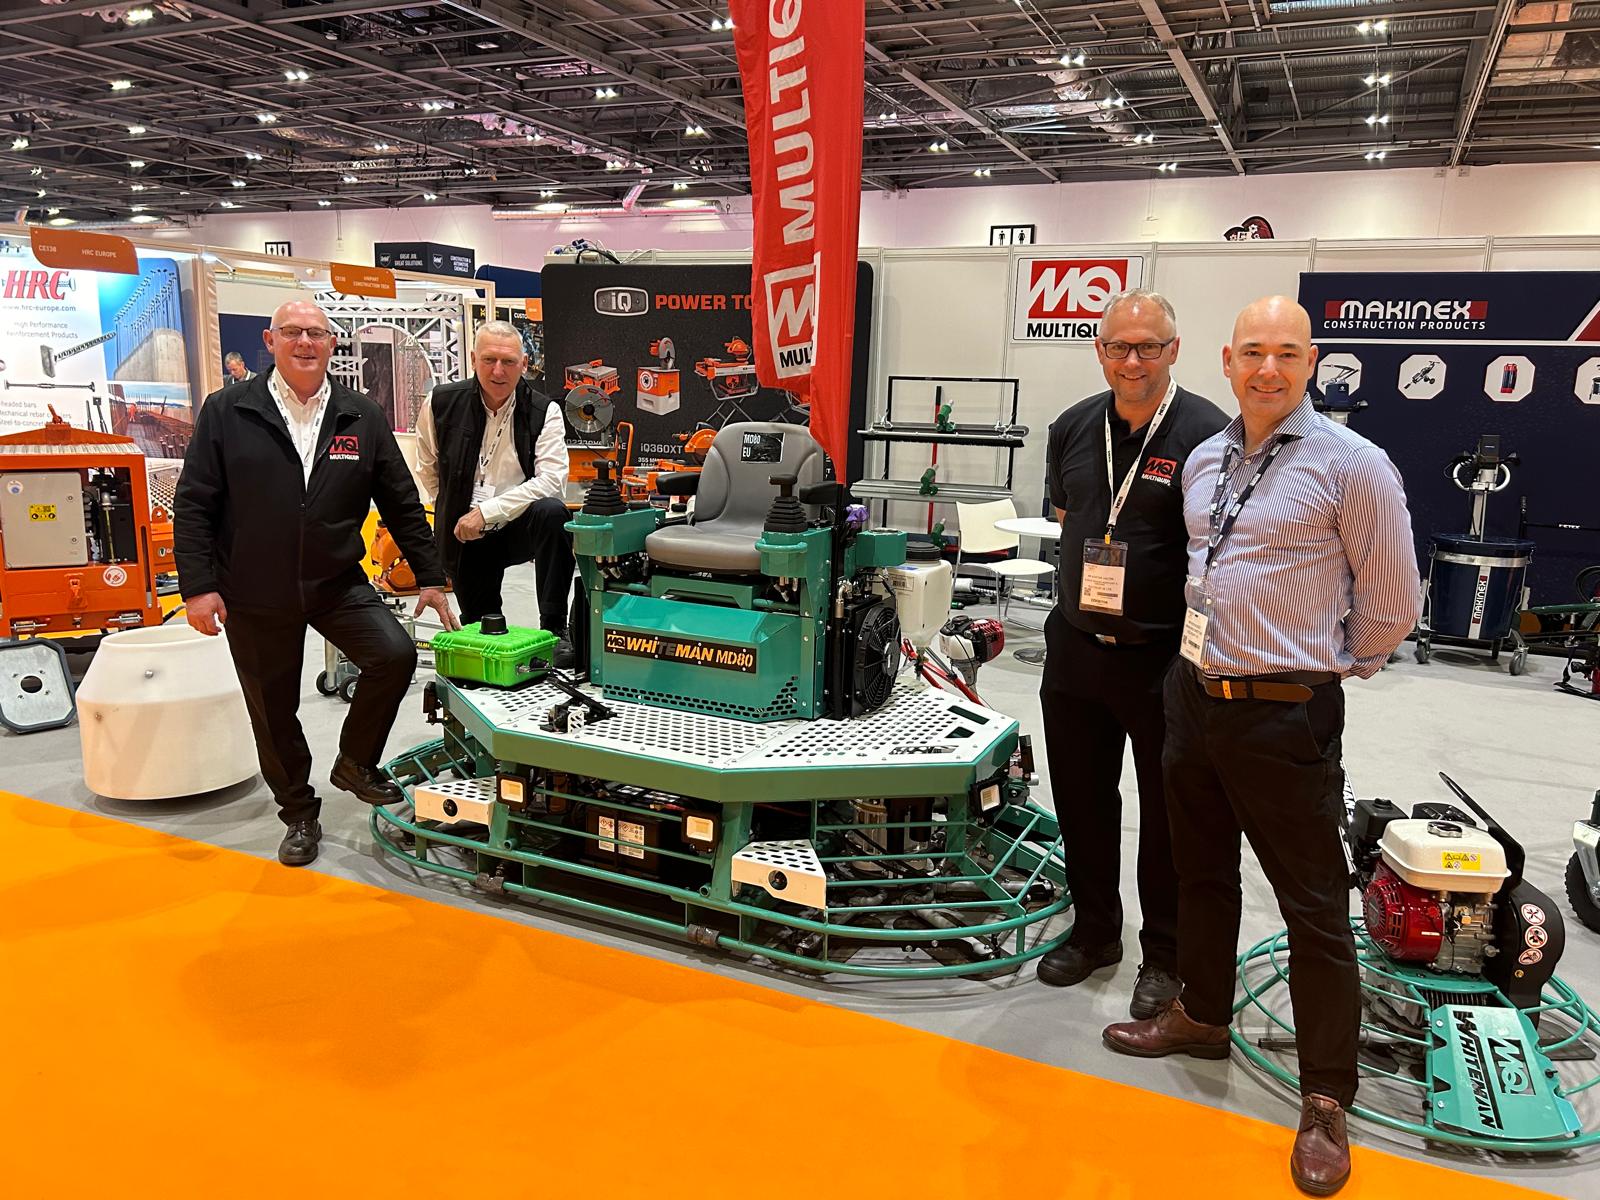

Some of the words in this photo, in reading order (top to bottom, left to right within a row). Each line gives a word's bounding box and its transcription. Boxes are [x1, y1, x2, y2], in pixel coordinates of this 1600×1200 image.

[95, 250, 117, 258] EUROPE
[3, 270, 69, 300] HRC
[1028, 266, 1121, 312] MQ
[611, 292, 632, 312] iQ
[655, 294, 726, 310] POWER
[1340, 300, 1472, 319] MAKINEX
[29, 321, 68, 329] Performance
[1323, 320, 1415, 330] CONSTRUCTION
[1420, 321, 1486, 330] PRODUCTS
[640, 443, 683, 455] iQ360XT
[742, 446, 752, 458] EU
[1143, 458, 1176, 477] MQ
[1473, 580, 1487, 619] MAKINEX
[608, 634, 625, 648] MQ
[626, 636, 714, 662] WHITEMAN
[715, 649, 754, 668] MD80
[1453, 1010, 1499, 1129] WHITEMAN
[1490, 1038, 1536, 1096] MQ
